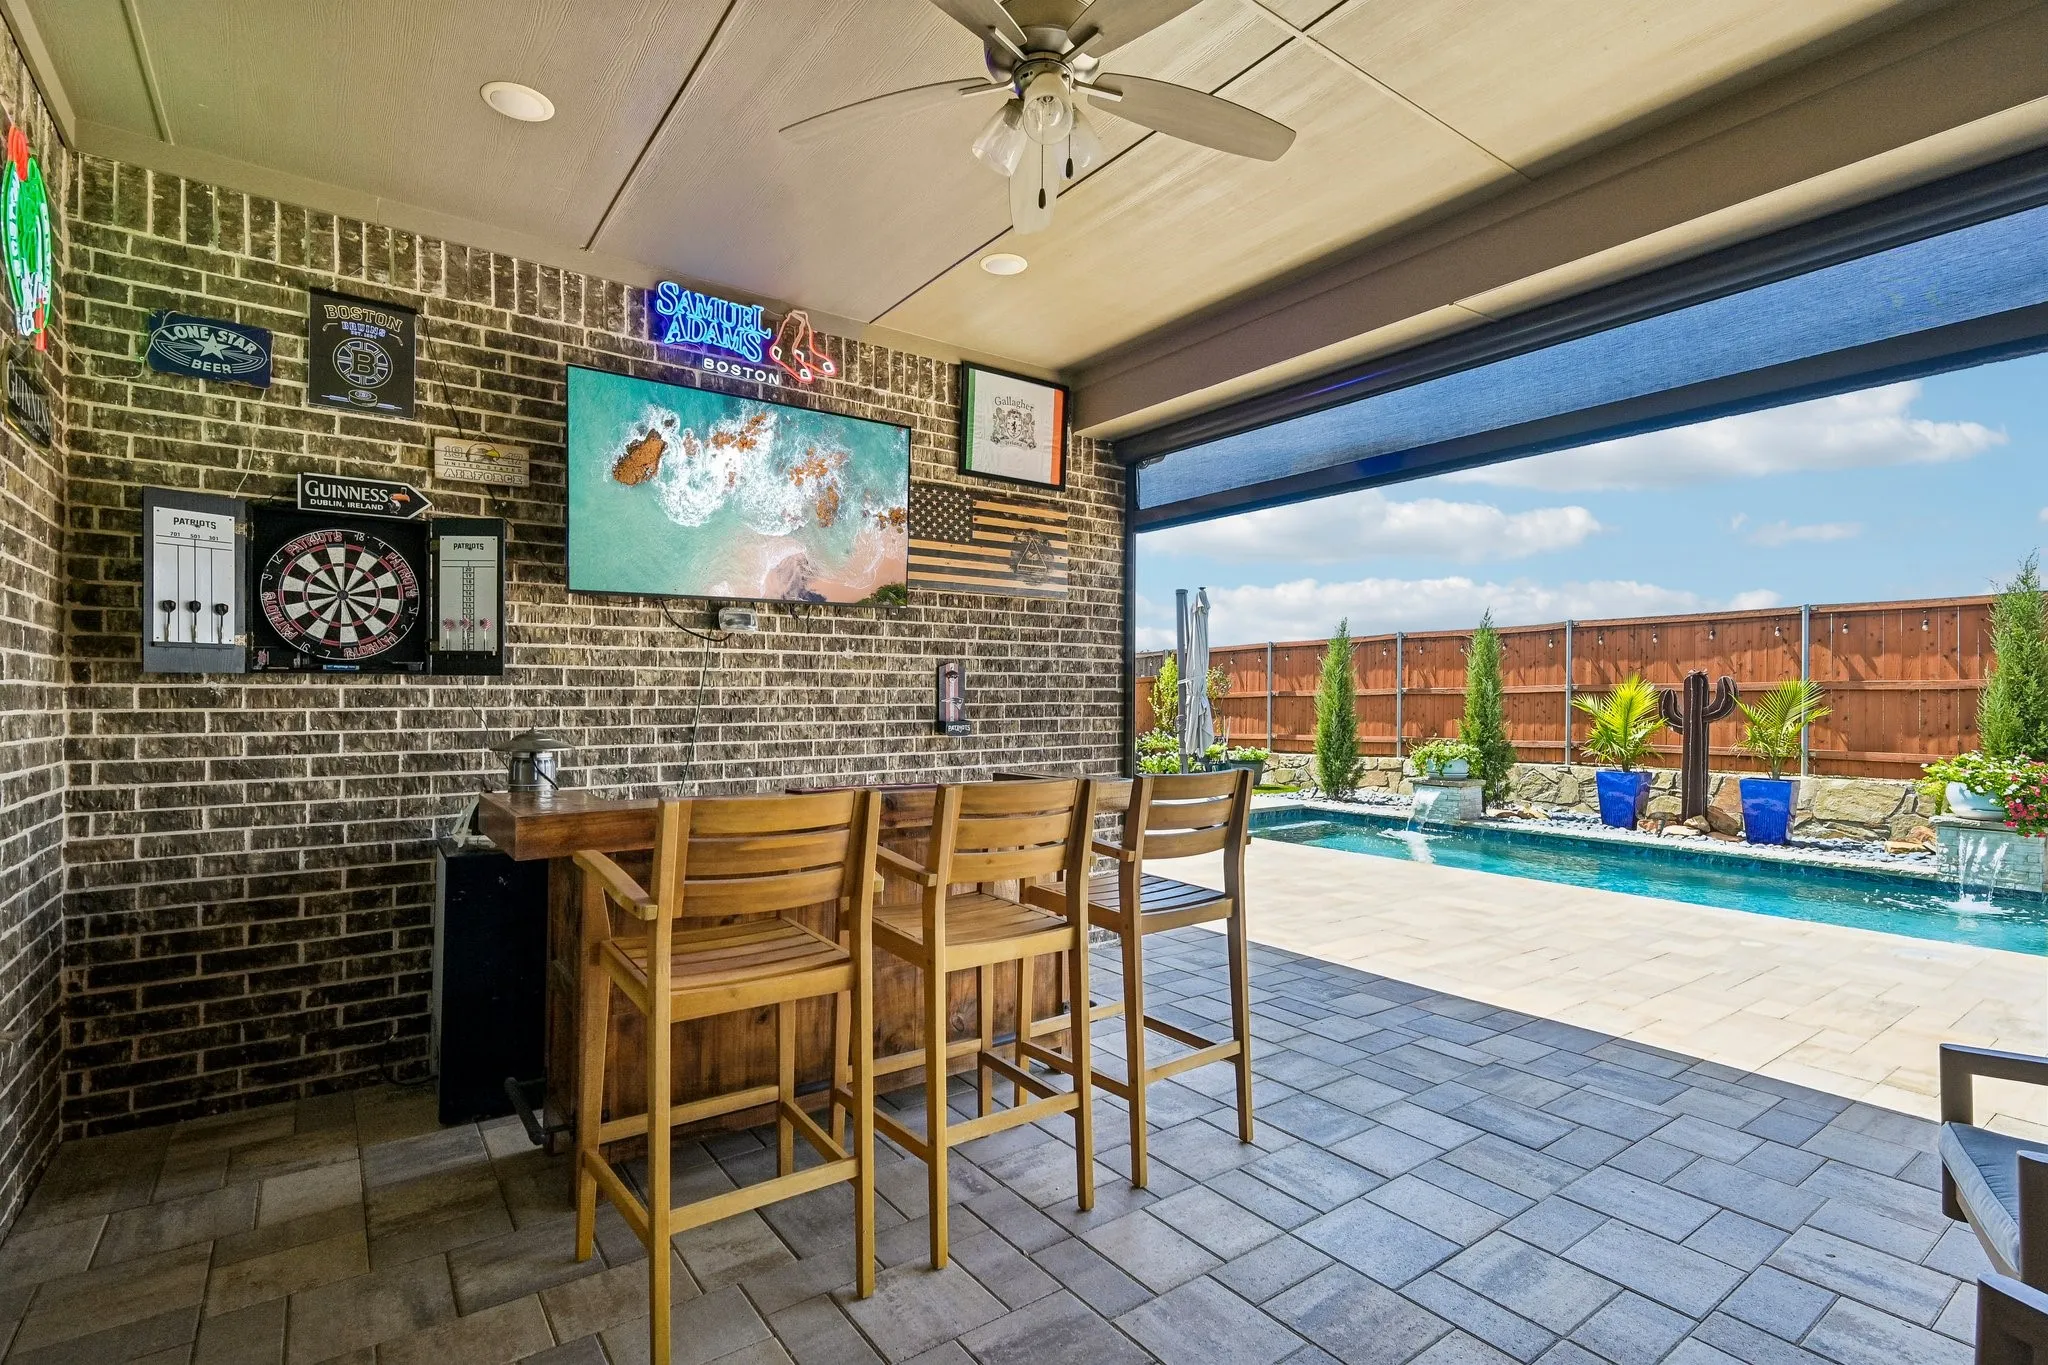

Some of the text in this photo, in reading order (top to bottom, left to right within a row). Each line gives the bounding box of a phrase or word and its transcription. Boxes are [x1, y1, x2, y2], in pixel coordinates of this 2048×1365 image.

[323, 304, 403, 333] BOSTON
[656, 281, 772, 339] SAMUEL
[162, 325, 258, 355] LONE STAR
[341, 320, 387, 338] BRUINS
[663, 312, 762, 362] ADAMS
[191, 359, 232, 374] BEER
[703, 357, 780, 386] BOSTON
[7, 359, 50, 437] GUINNESS
[994, 396, 1034, 411] Gallagher
[444, 461, 522, 473] UNITED STATES
[304, 480, 389, 502] GUINNESS
[310, 498, 384, 511] DUBLIN, IRELAND
[173, 517, 217, 530] PATRIOTS
[284, 531, 343, 556] PATRIOTS
[453, 543, 485, 551] PATRIOTS
[385, 551, 418, 598] PATRIOTS
[261, 591, 299, 640] PATRIOTS
[343, 631, 399, 659] PATRIOTS
